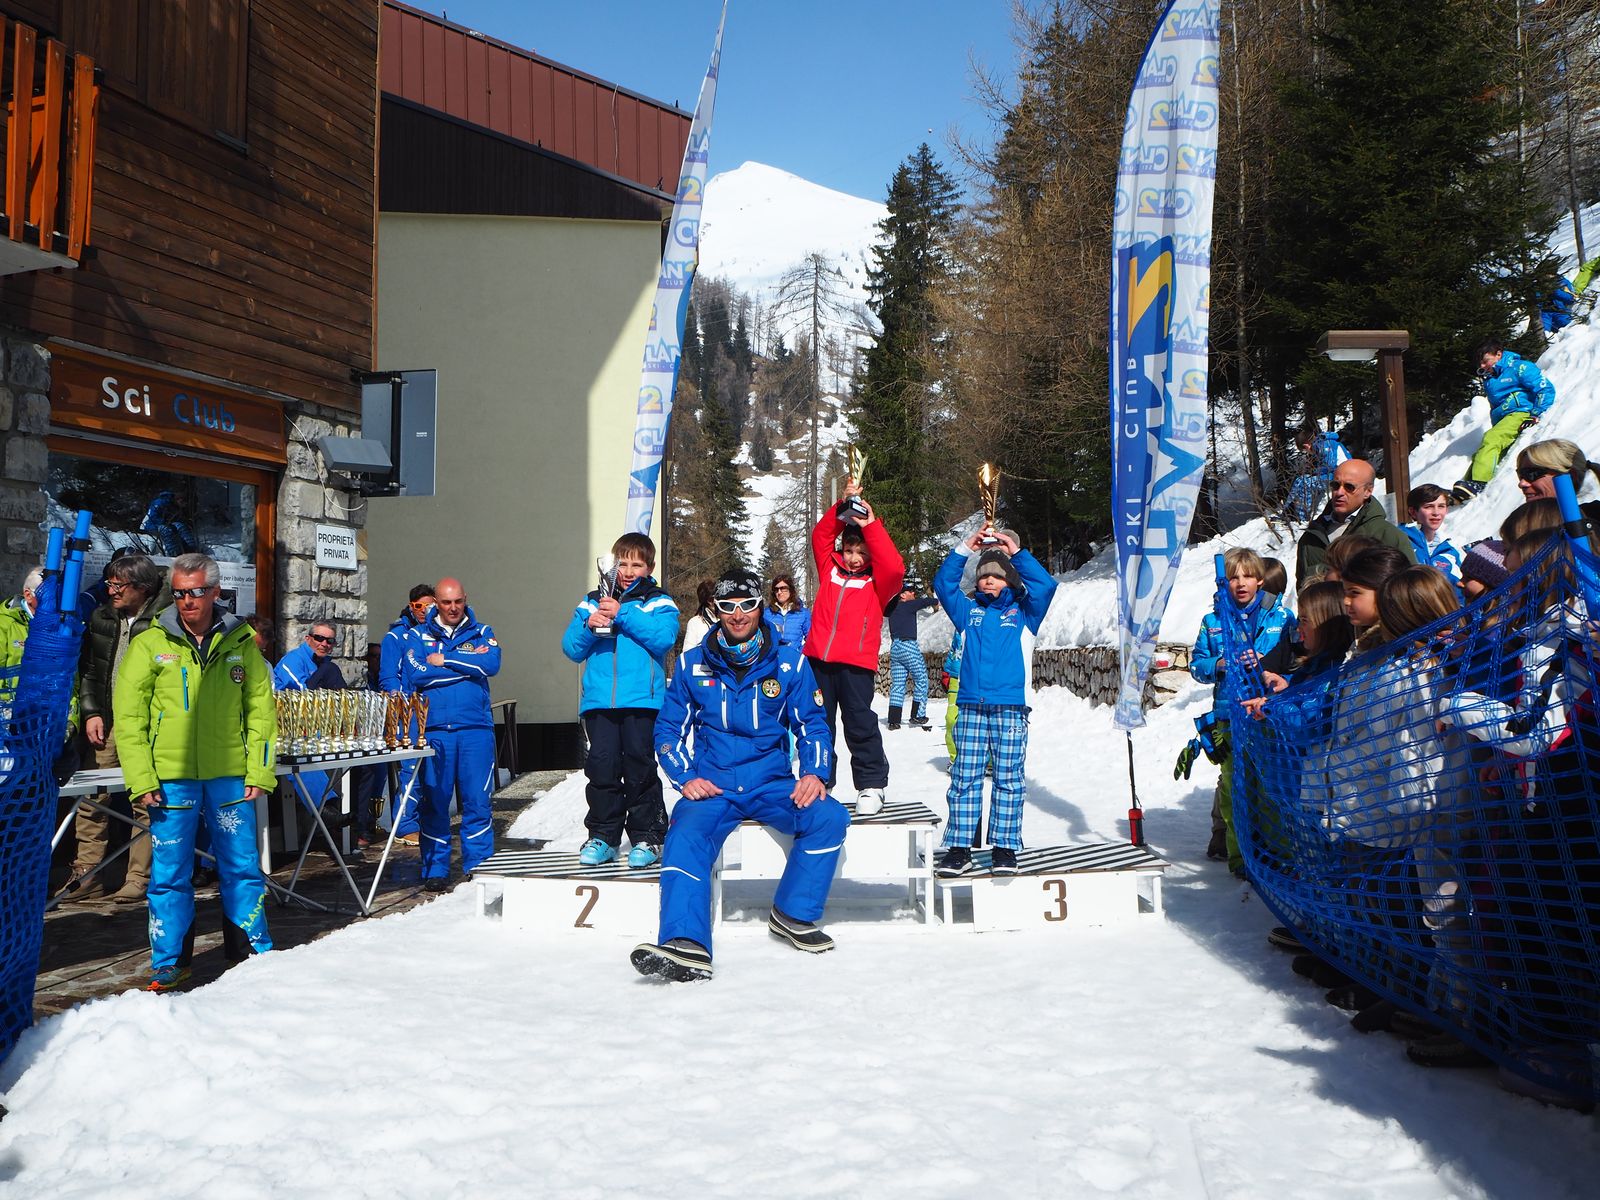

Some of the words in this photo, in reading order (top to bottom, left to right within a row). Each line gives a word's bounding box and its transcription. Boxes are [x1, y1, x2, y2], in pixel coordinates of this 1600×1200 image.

[101, 376, 151, 416] Sci
[173, 393, 235, 432] Club
[639, 387, 662, 411] 2
[323, 548, 350, 560] PRIVATA
[574, 885, 600, 929] 2
[1042, 879, 1068, 922] 3
